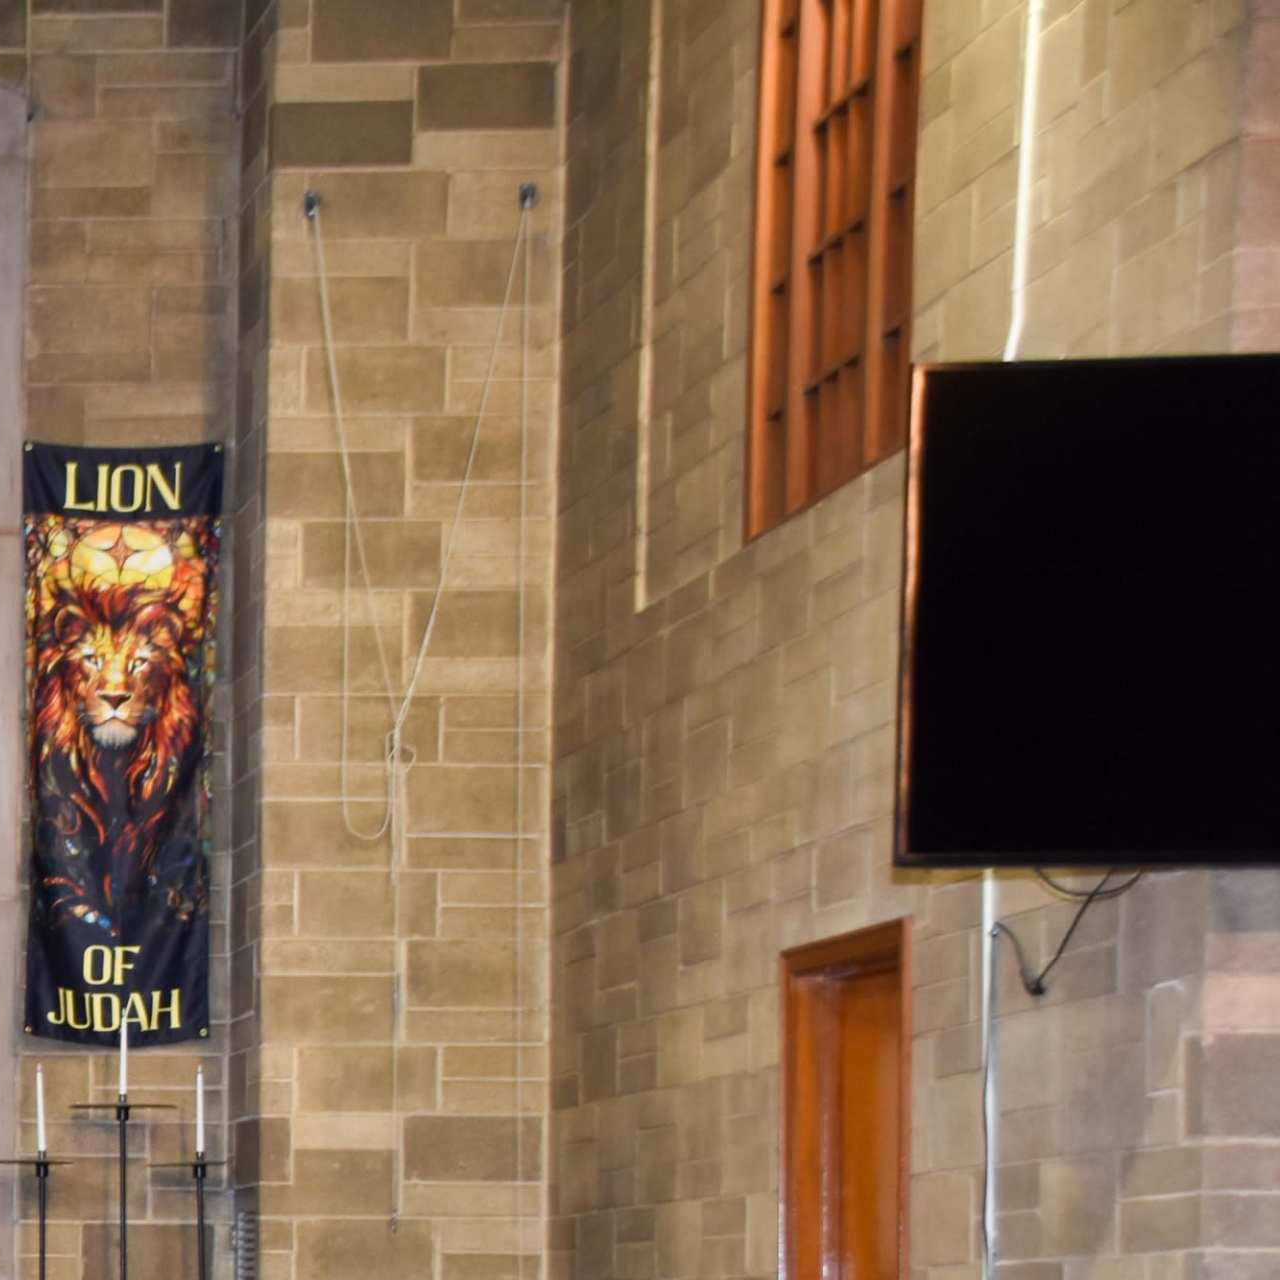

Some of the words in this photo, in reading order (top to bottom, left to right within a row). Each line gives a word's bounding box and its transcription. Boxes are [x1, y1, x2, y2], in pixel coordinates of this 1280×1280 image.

[63, 462, 182, 513] LION
[83, 944, 142, 986] OF
[47, 987, 181, 1032] JUDAH
